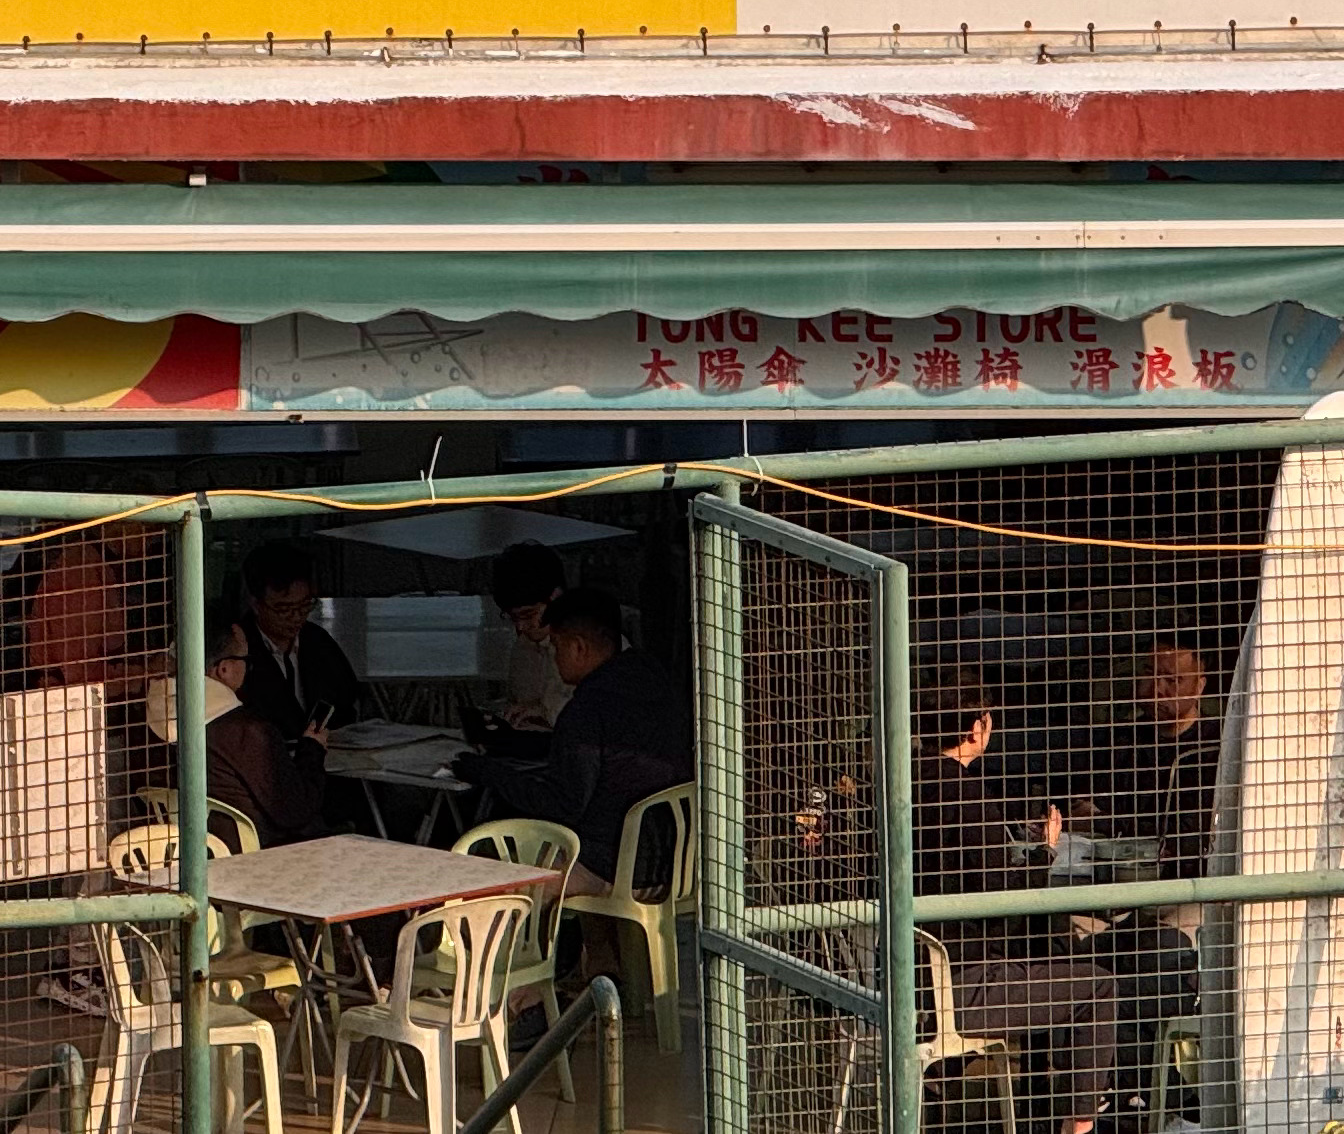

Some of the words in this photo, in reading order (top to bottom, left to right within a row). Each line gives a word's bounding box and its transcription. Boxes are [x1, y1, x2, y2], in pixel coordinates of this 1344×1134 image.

[637, 346, 807, 393] 太陽傘
[853, 347, 1023, 393] 沙灘椅
[1070, 346, 1240, 393] 滑浪板
